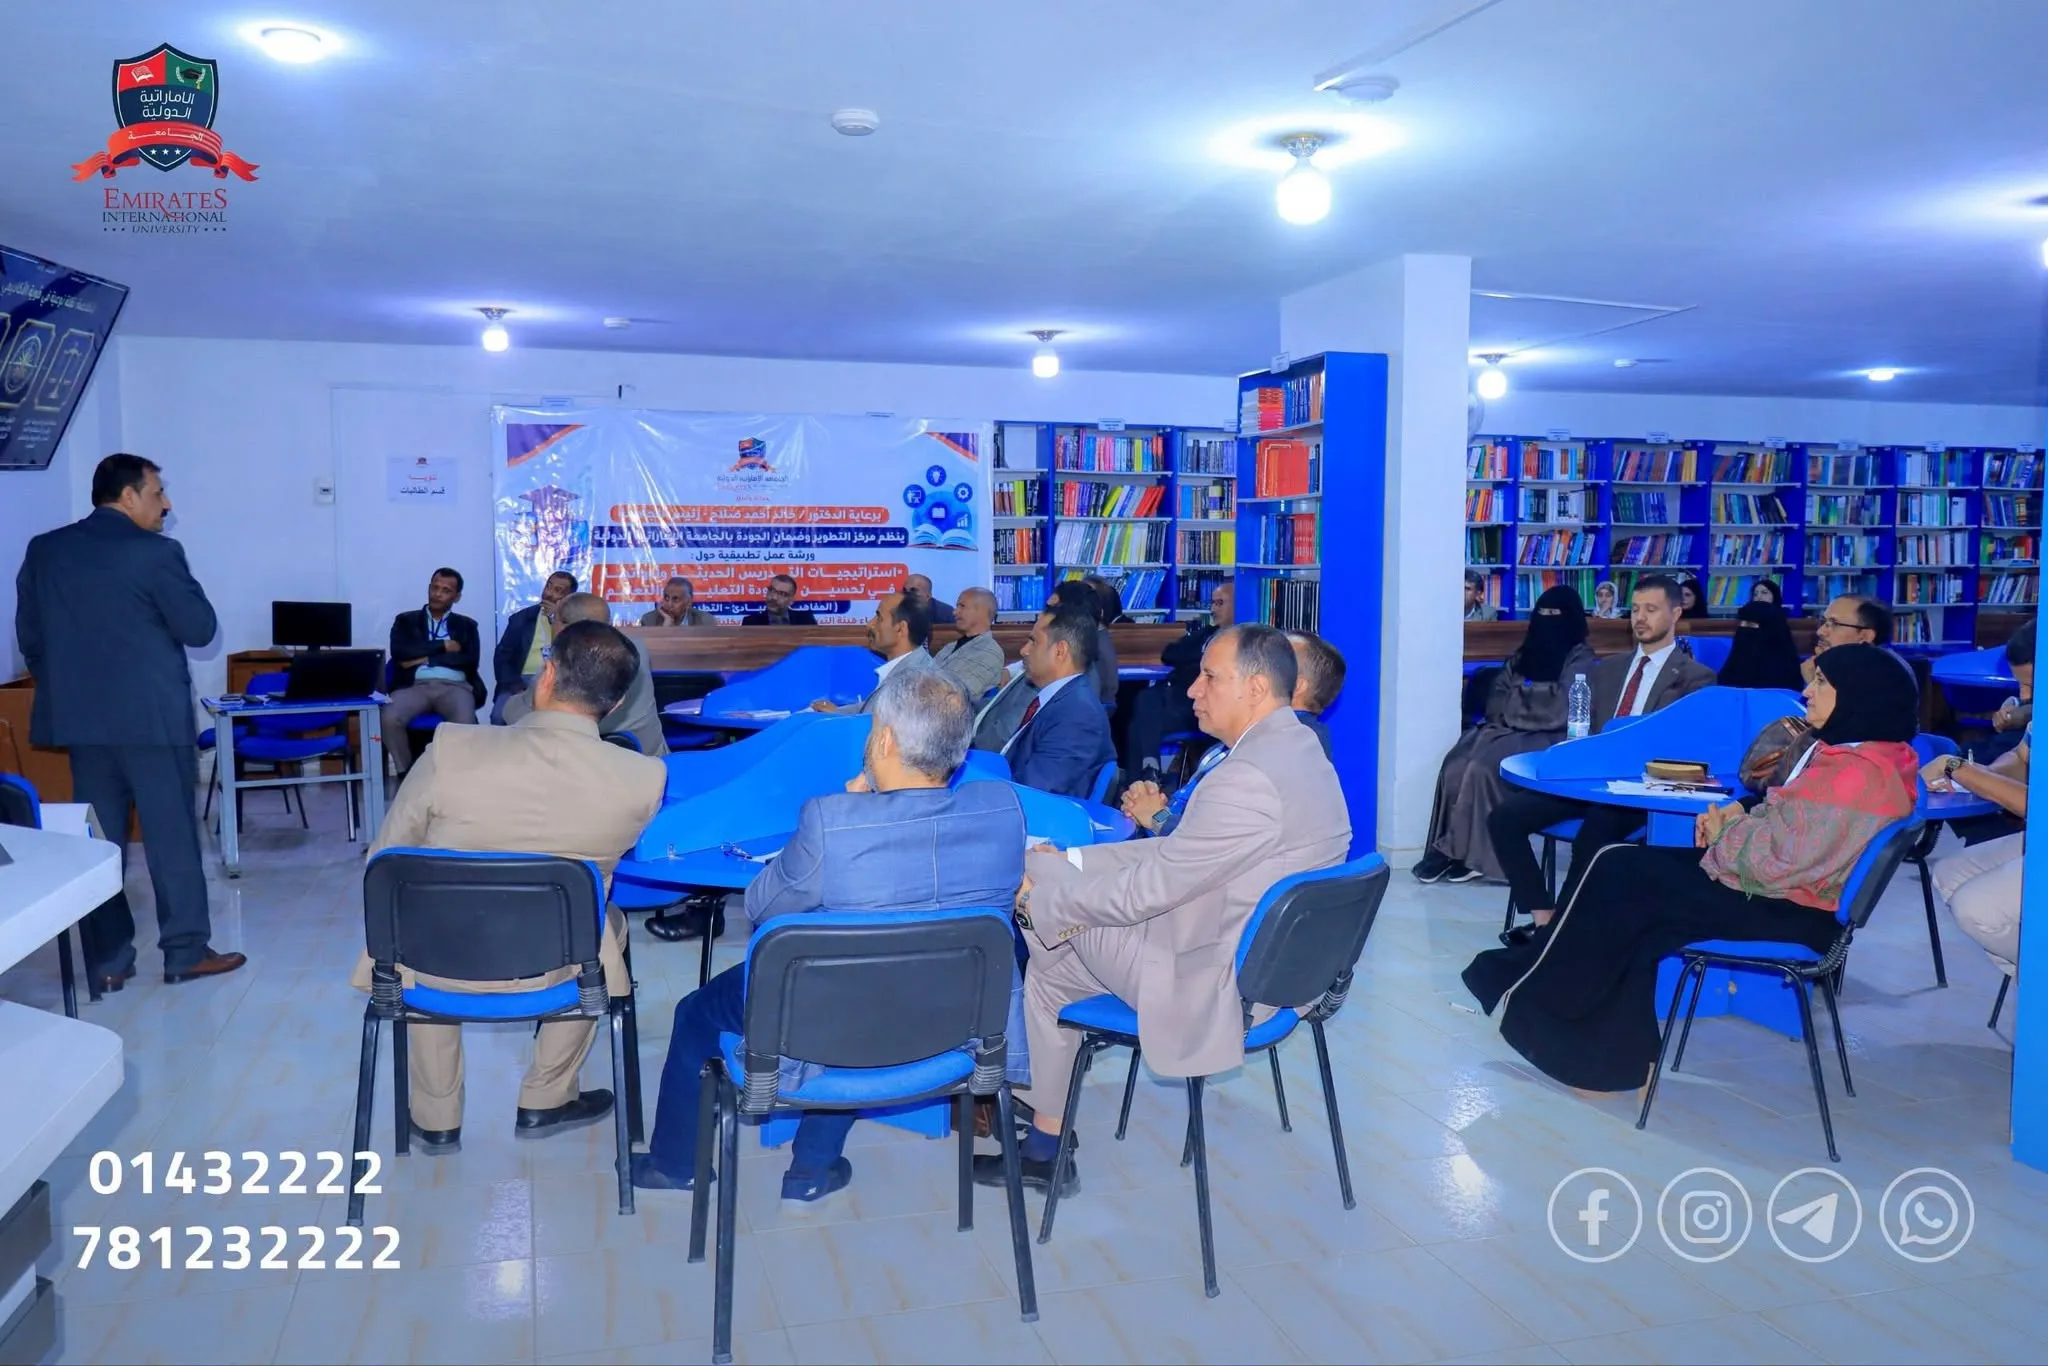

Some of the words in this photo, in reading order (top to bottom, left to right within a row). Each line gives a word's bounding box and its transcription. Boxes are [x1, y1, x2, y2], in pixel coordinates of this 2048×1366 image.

[807, 509, 846, 522] الدكتور
[849, 509, 882, 521] برعاية
[686, 530, 734, 543] بالجامعة
[737, 531, 770, 544] الجودة
[773, 531, 811, 543] وضمان
[812, 531, 851, 544] التطوير
[853, 530, 876, 543] مركز
[878, 531, 905, 545] ينظم
[719, 551, 760, 561] تطبيقية
[764, 551, 785, 561] عمل
[788, 551, 815, 561] ورشة
[671, 565, 734, 581] الحديثة
[692, 583, 745, 598] التعلي
[800, 583, 865, 597] تحسين
[868, 584, 896, 599] في
